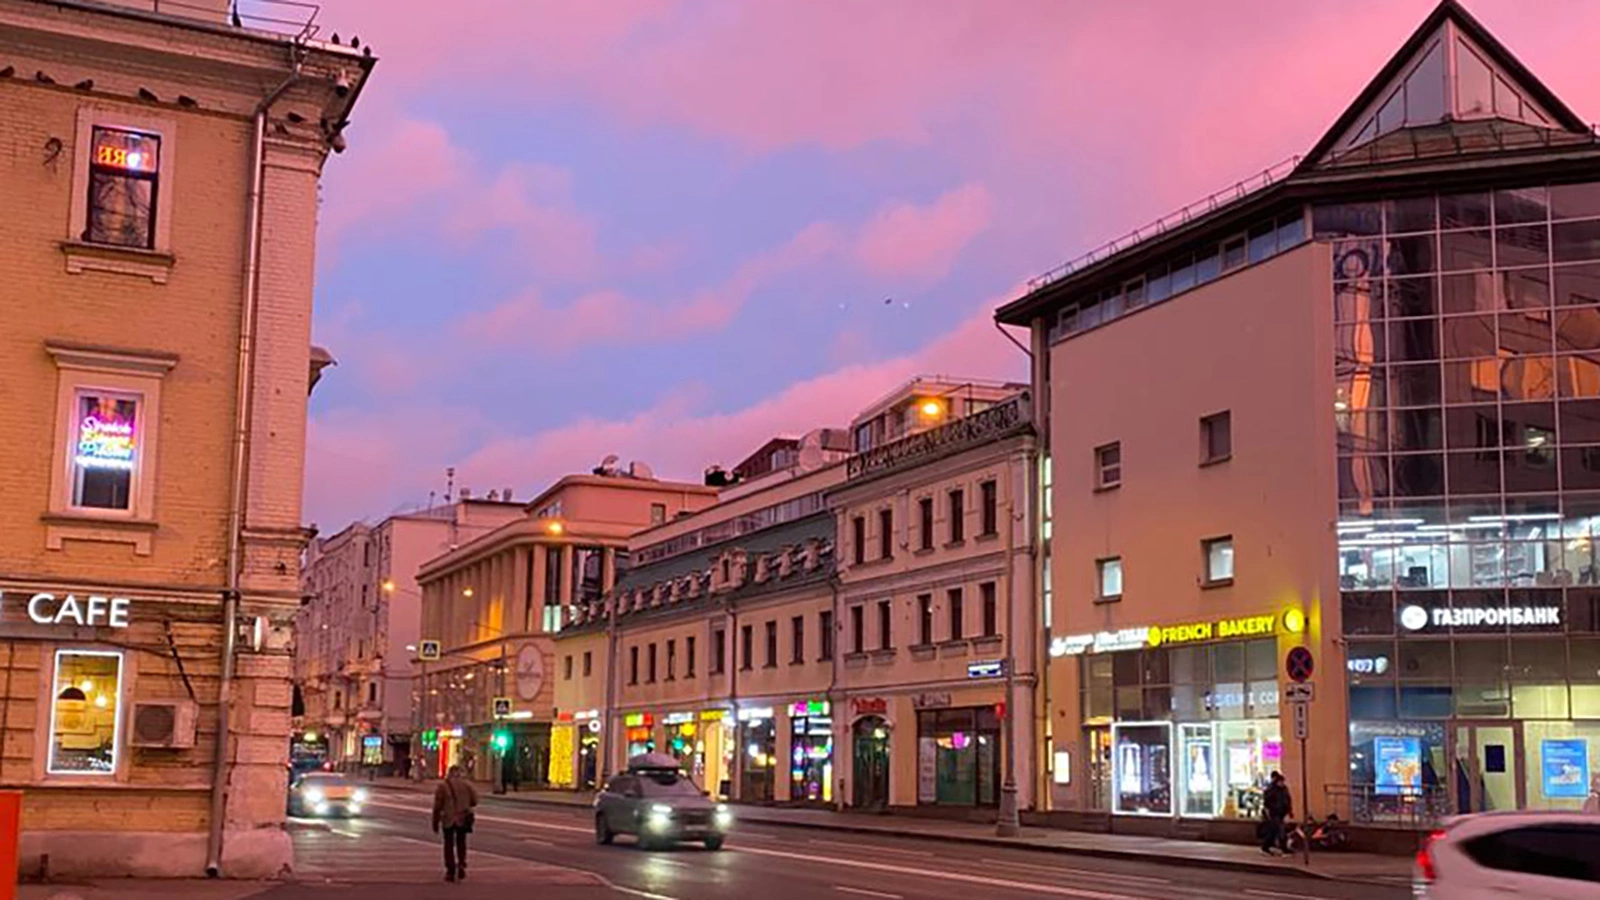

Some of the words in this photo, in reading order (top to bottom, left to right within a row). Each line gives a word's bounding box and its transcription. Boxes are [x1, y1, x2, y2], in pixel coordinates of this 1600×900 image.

[28, 592, 130, 627] CAFE
[1432, 606, 1560, 626] ГАЗПРОМБАНК
[1161, 622, 1212, 643] FRENCH
[1219, 615, 1275, 638] BAKERY
